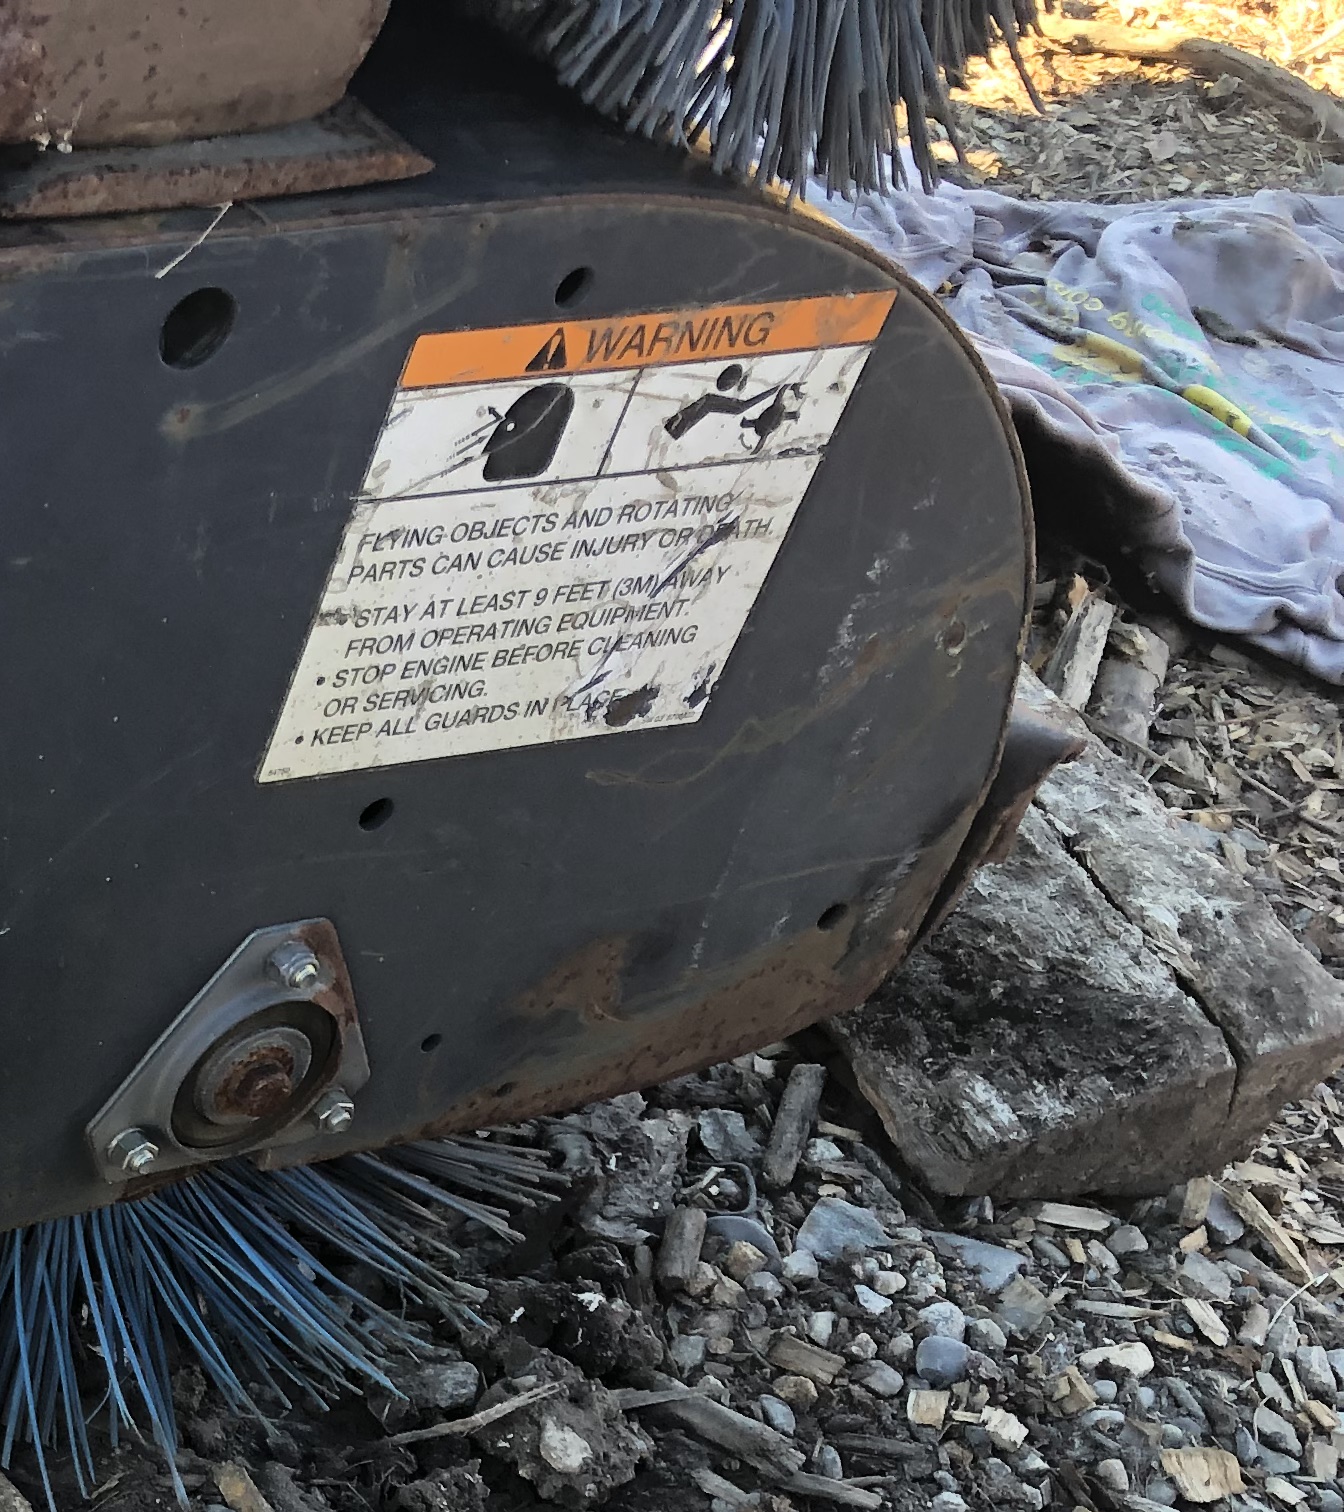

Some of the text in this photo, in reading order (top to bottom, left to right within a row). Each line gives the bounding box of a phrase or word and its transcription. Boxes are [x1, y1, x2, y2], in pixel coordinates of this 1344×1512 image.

[586, 311, 775, 364] WARNING
[347, 516, 775, 584] PARTS CAN CAUSE INJURY OR DATH.
[357, 492, 734, 554] FLYING OBJECTS AND ROTATING
[354, 565, 732, 629] STAY AT LEAST 9 FEET (3M) AWAY
[332, 624, 699, 689] STOP ENGINE BEFORE CLEANING
[344, 599, 691, 659] FROM OPERATING EQUIPMENT.
[311, 722, 373, 748] KEEP
[375, 716, 417, 738] ALL
[424, 701, 520, 732] GUARDS
[523, 699, 549, 718] IN
[323, 679, 489, 718] OR SERVICING.
